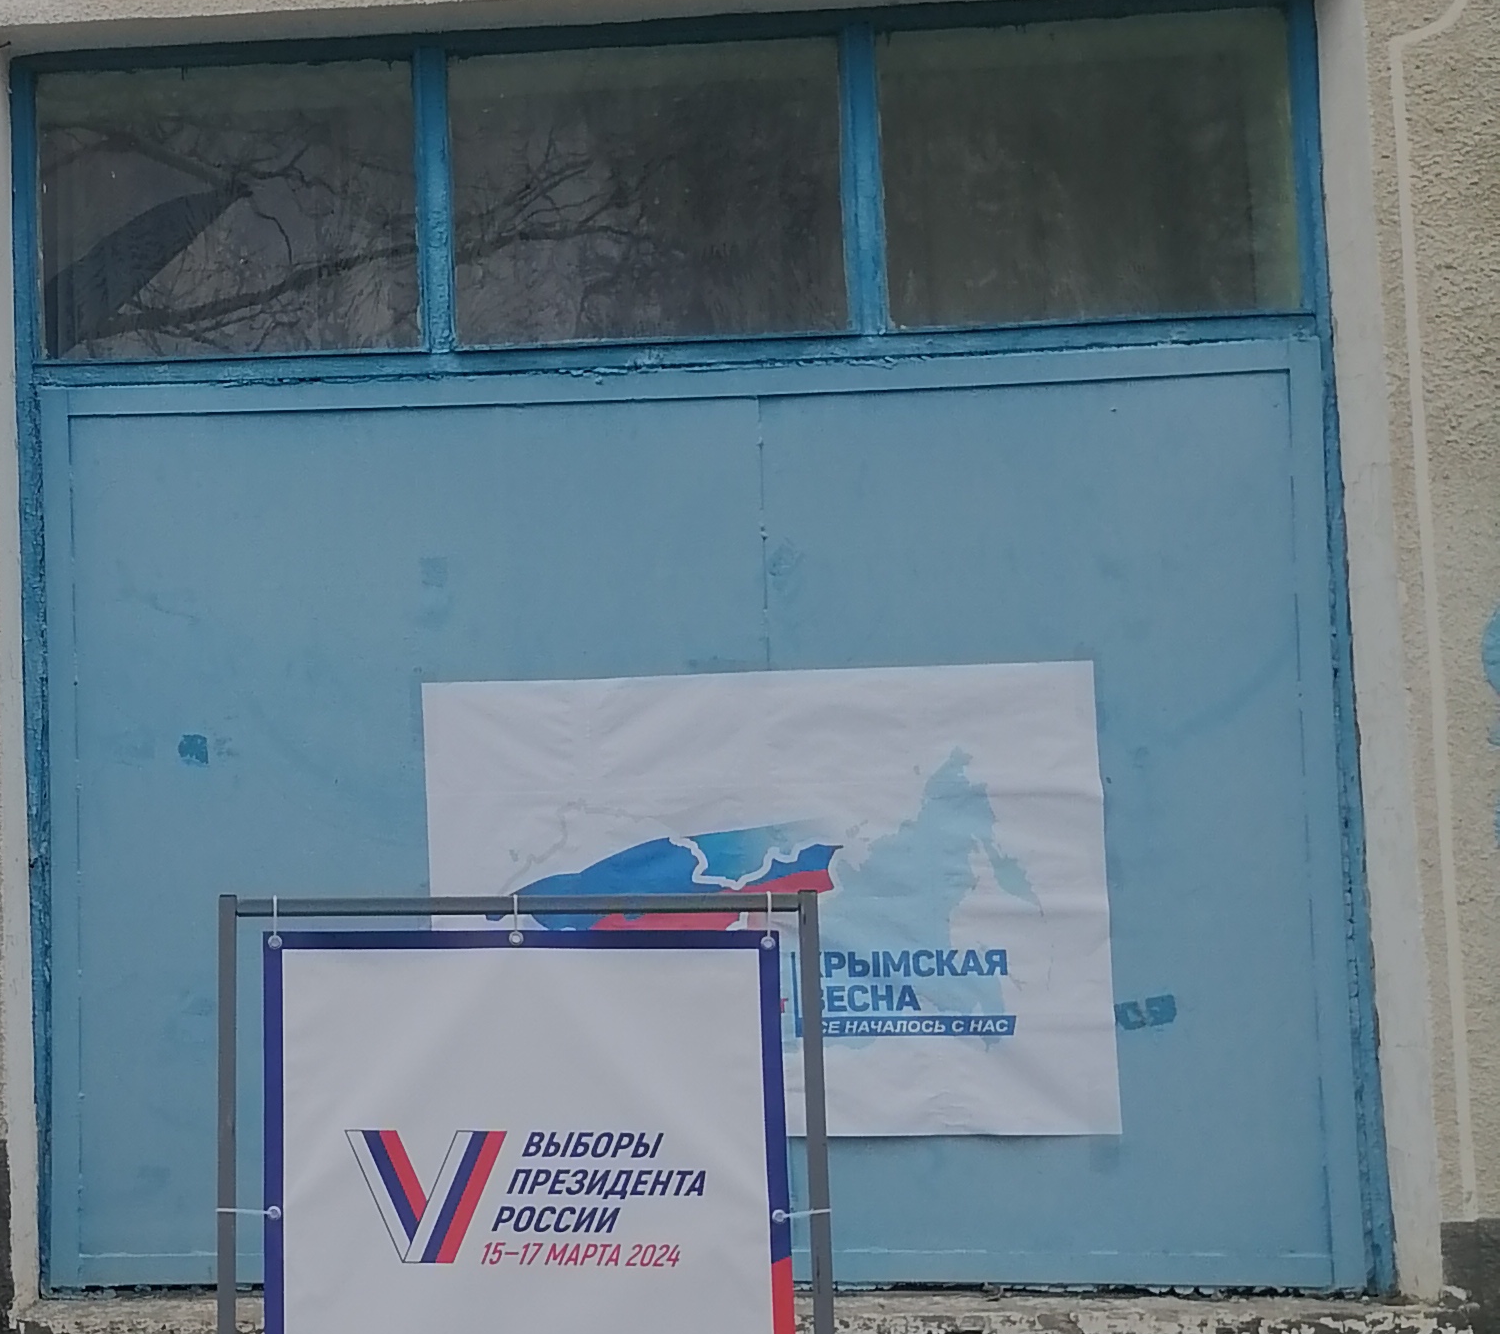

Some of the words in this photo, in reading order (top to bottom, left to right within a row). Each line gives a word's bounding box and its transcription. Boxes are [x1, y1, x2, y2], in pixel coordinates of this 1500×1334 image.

[844, 1019, 946, 1034] НАЧАЛОСЬ
[951, 1019, 964, 1032] С
[969, 1019, 1009, 1033] НАС
[521, 1131, 664, 1159] ВЫБОРЫ
[506, 1168, 707, 1200] ПРЕЗИДЕНТА
[491, 1205, 621, 1234] РОССИИ
[546, 1243, 622, 1267] МАРТА
[624, 1244, 681, 1268] 2024
